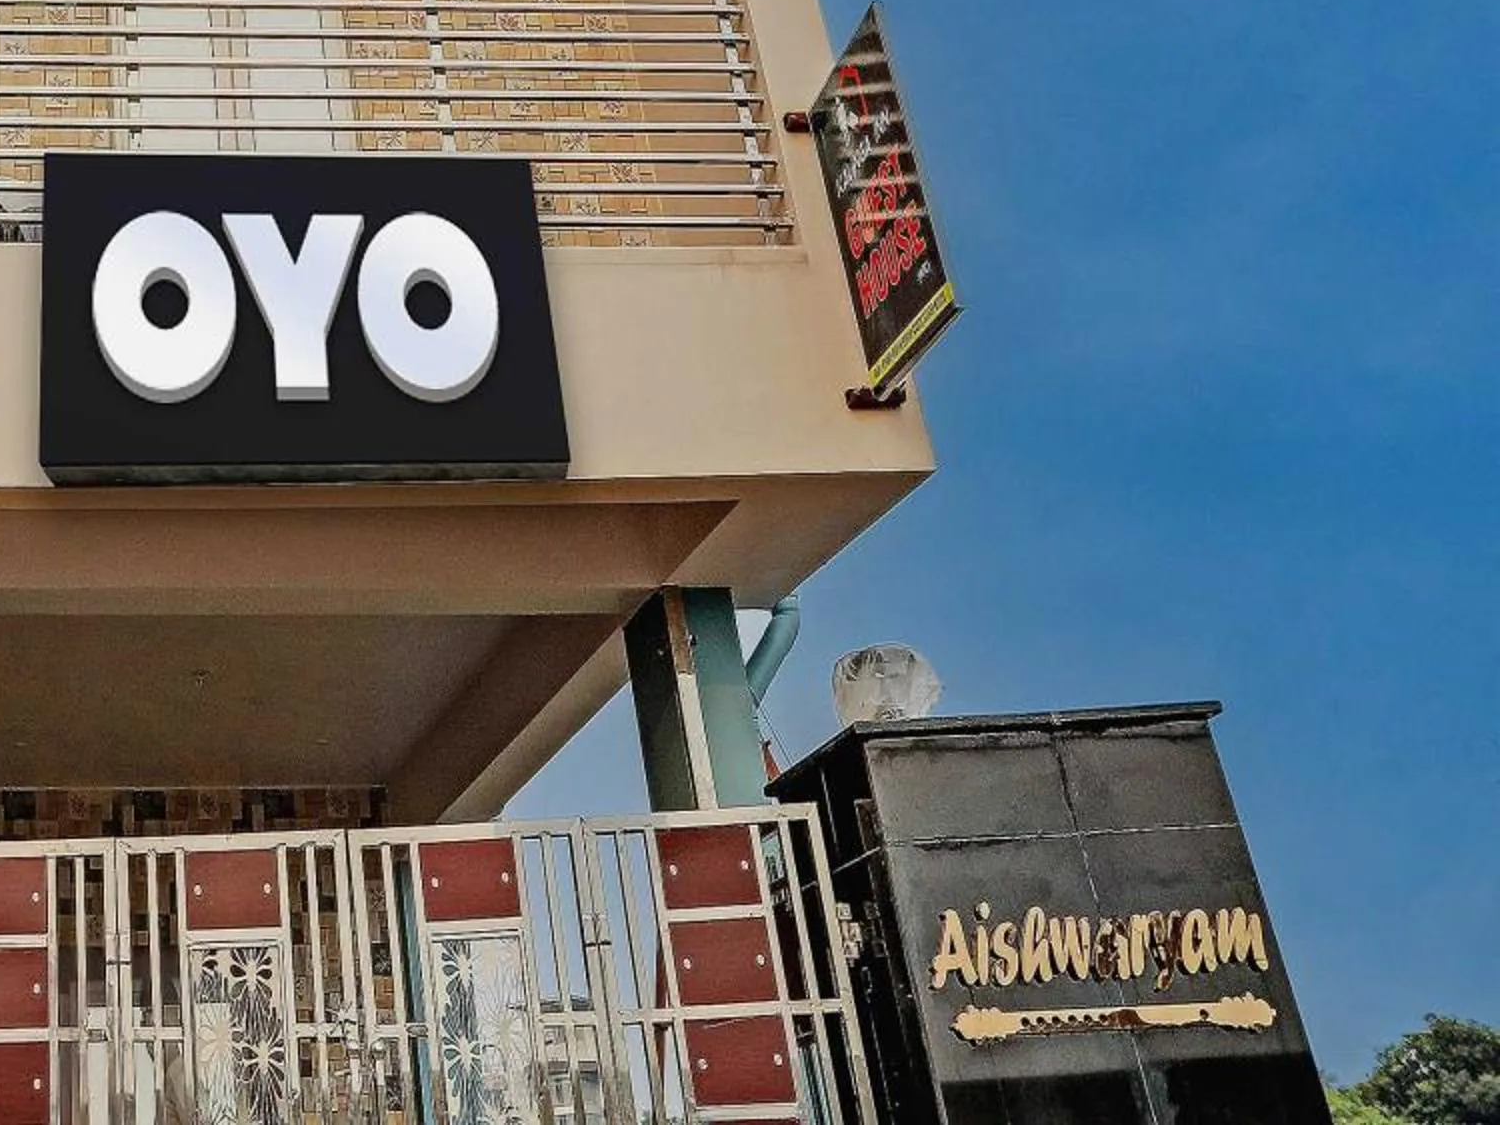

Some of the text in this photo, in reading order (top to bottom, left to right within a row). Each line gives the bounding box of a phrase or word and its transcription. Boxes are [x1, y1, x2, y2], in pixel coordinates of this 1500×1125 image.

[92, 210, 499, 403] OYO
[855, 199, 926, 319] HOUSE
[930, 900, 1269, 991] Aishwaryam
